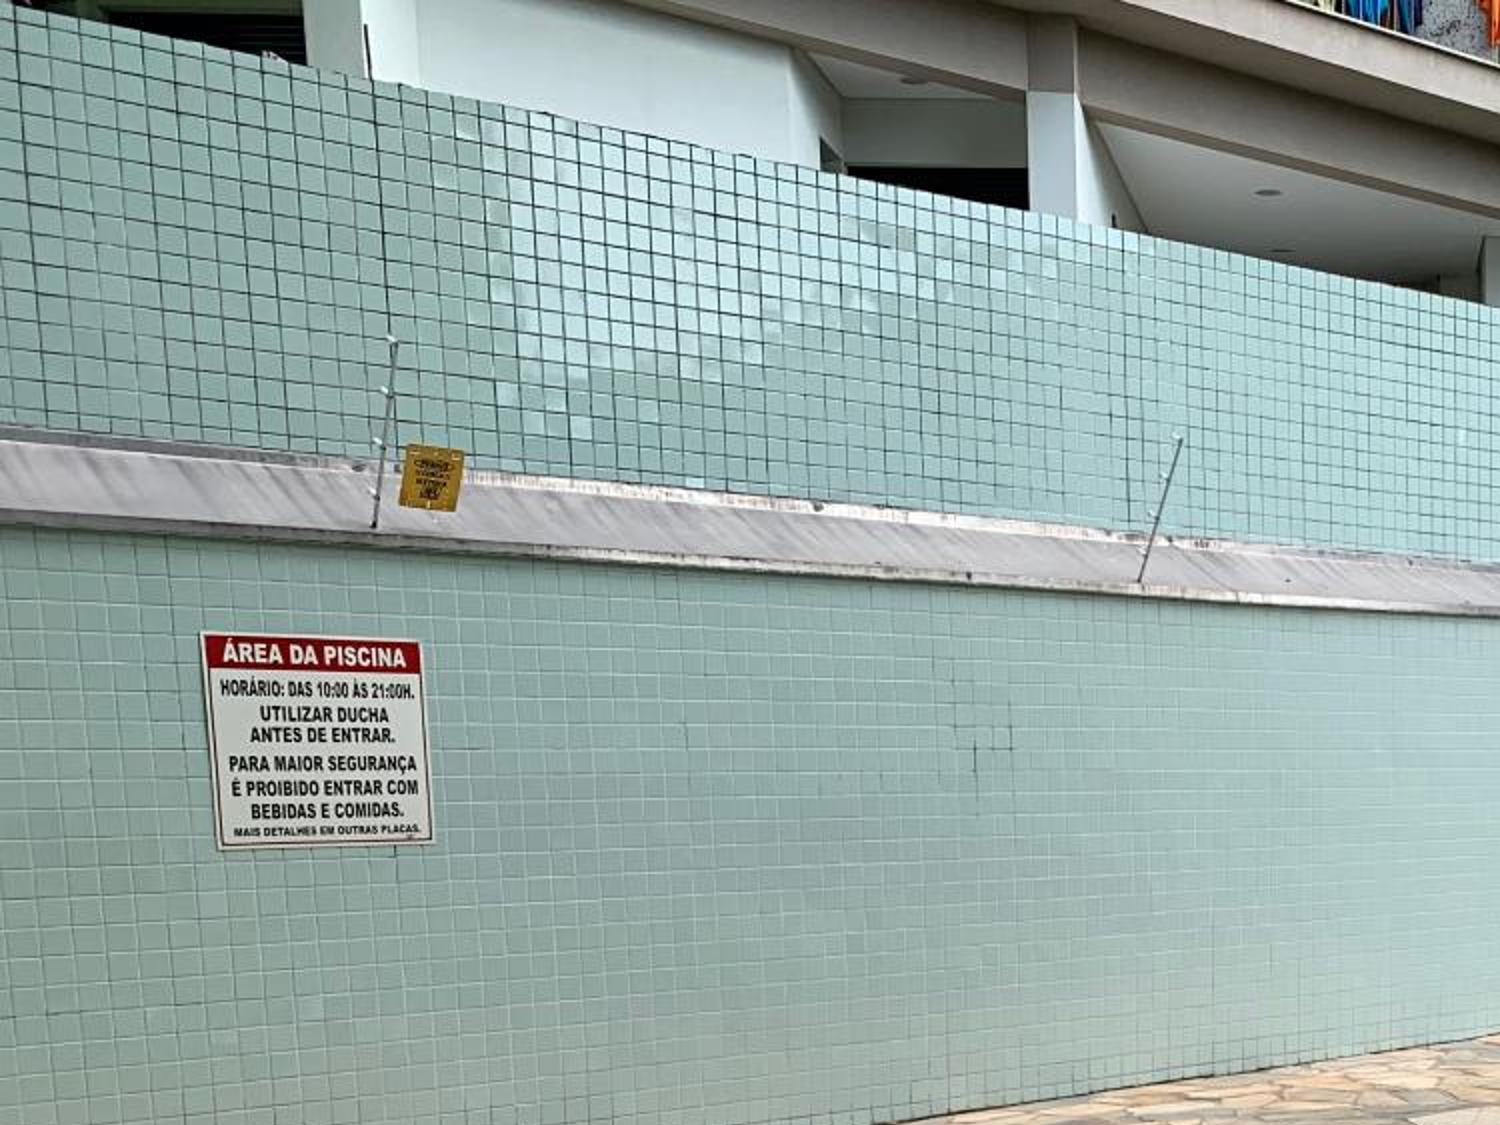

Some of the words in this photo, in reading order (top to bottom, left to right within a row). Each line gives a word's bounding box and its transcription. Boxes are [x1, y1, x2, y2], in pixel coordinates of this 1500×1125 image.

[223, 638, 283, 665] ÁREA
[289, 643, 318, 666] DA
[323, 646, 407, 668] PISCINA
[220, 676, 285, 698] HORÁRIO:
[288, 682, 313, 698] DAS
[317, 682, 349, 699] 10:00
[371, 683, 415, 700] 21:00H.
[260, 705, 332, 722] UTILIZAR
[337, 707, 389, 723] DUCHA
[250, 727, 302, 743] ANTES
[307, 727, 327, 743] DE
[332, 727, 396, 743] ENTRAR.
[229, 755, 270, 772] PARA
[274, 755, 324, 771] MAIOR
[328, 755, 417, 775] SEGURANÇA
[232, 777, 241, 797] É
[246, 780, 319, 797] PROIBIDO
[323, 779, 383, 796] ENTRAR
[387, 779, 419, 795] COM
[251, 803, 317, 819] BEBIDAS
[321, 803, 330, 818] E
[334, 801, 404, 818] COMIDAS.
[233, 827, 261, 837] MAIS
[263, 826, 317, 837] DETALHES
[320, 826, 335, 836] EM
[338, 824, 379, 835] OUTRAS
[381, 823, 422, 834] PLACAS.
